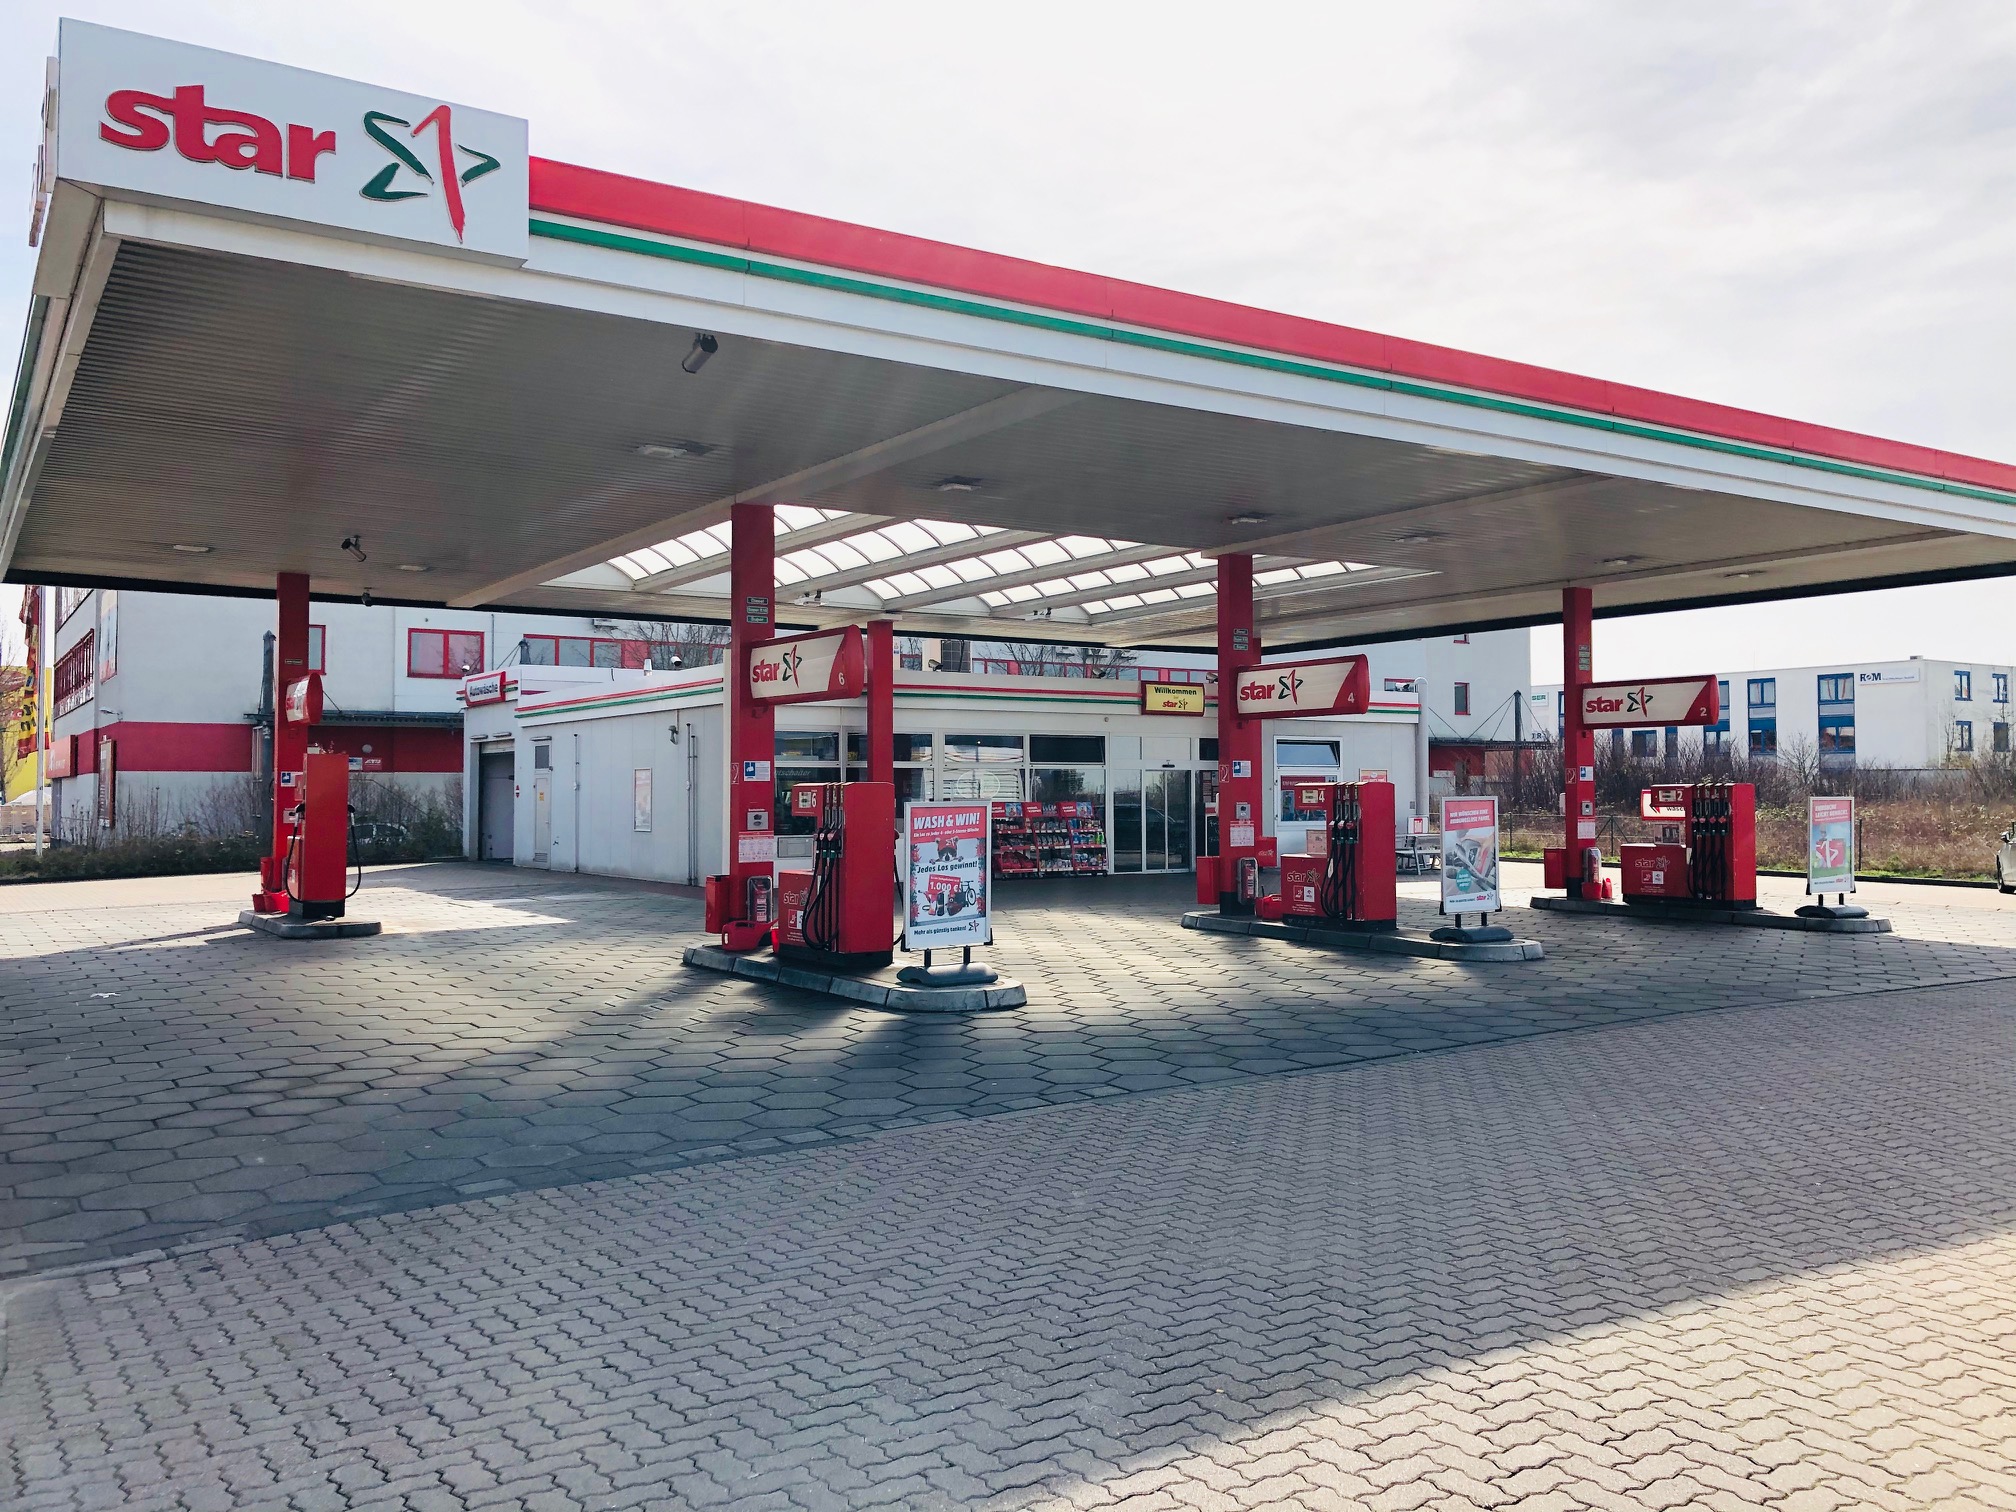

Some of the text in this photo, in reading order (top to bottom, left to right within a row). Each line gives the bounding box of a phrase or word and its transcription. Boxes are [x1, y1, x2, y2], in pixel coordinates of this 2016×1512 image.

[99, 84, 336, 183] star
[752, 659, 780, 683] star
[838, 672, 845, 686] 6
[470, 682, 498, 697] Autowäsche
[1154, 686, 1197, 696] Willkommen
[1240, 681, 1275, 701] star
[1162, 700, 1179, 708] star
[1347, 692, 1355, 704] 4
[1585, 696, 1624, 713] star
[1699, 707, 1708, 717] 2
[811, 792, 817, 808] 6
[1318, 790, 1326, 803] 4
[1677, 791, 1683, 801] 2
[913, 812, 980, 830] WASH & WIN!
[917, 861, 978, 874] Jedes Los gewinnt!
[1634, 858, 1655, 868] star
[1286, 870, 1306, 883] star
[930, 881, 952, 891] 1.000
[783, 891, 799, 905] star
